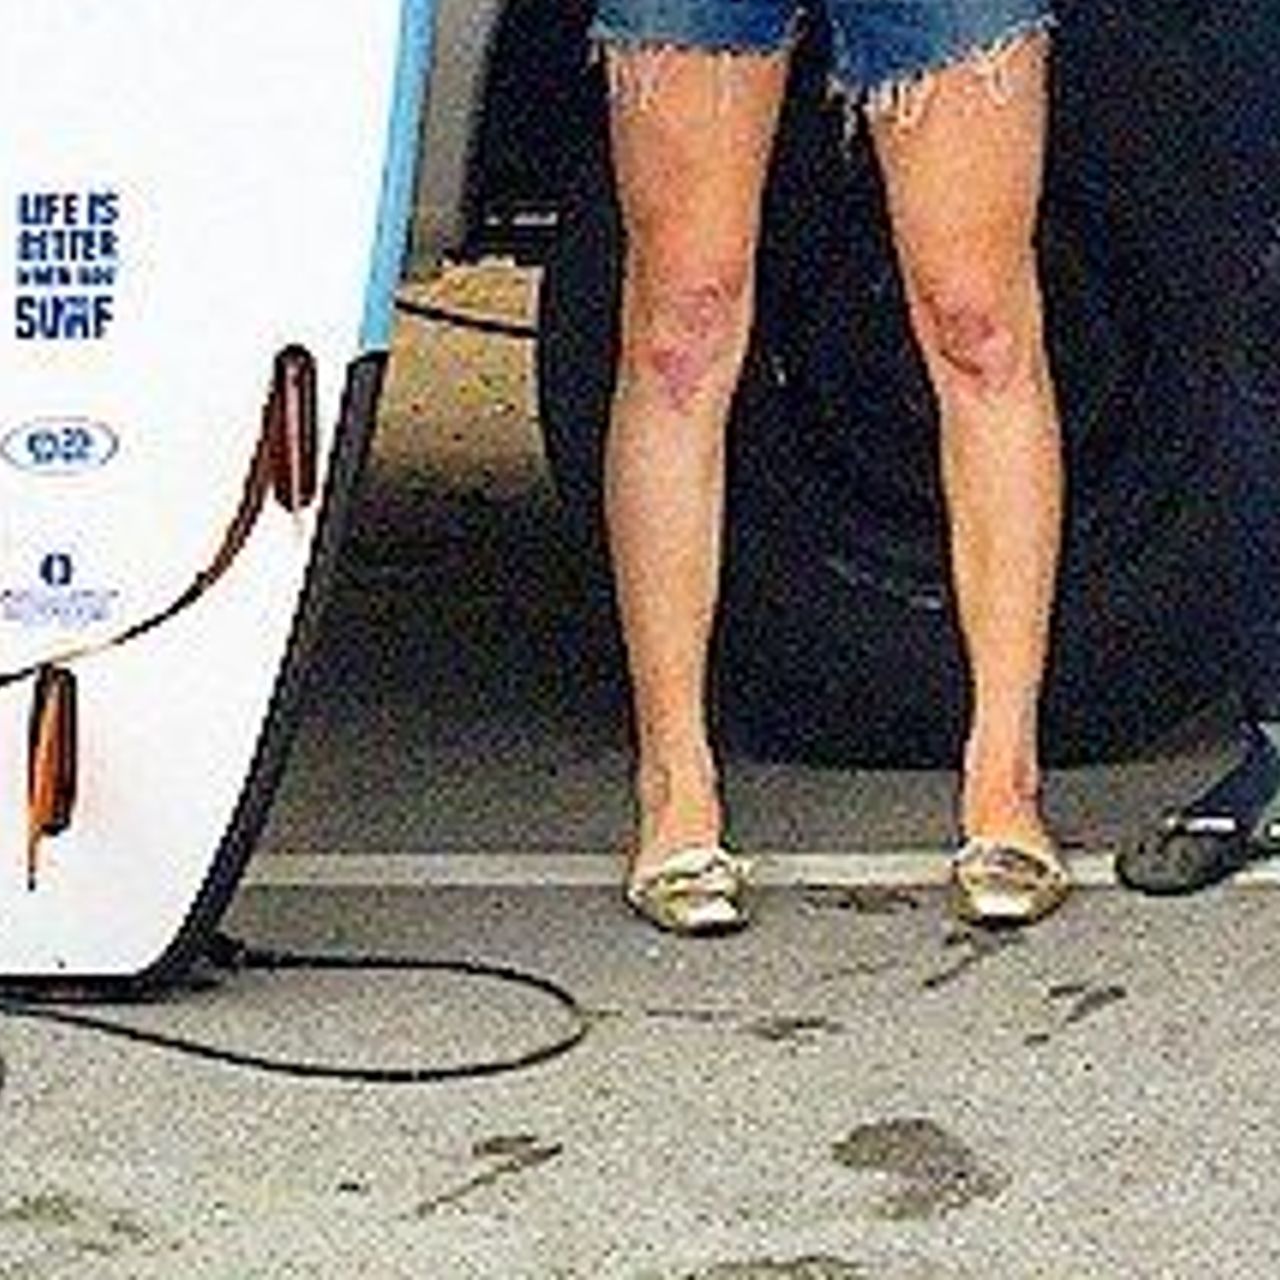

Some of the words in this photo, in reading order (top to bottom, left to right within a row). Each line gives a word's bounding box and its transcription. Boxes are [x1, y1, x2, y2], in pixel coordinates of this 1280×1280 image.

[20, 193, 77, 225] LIFE
[87, 192, 119, 225] IS
[15, 296, 114, 339] SURF
